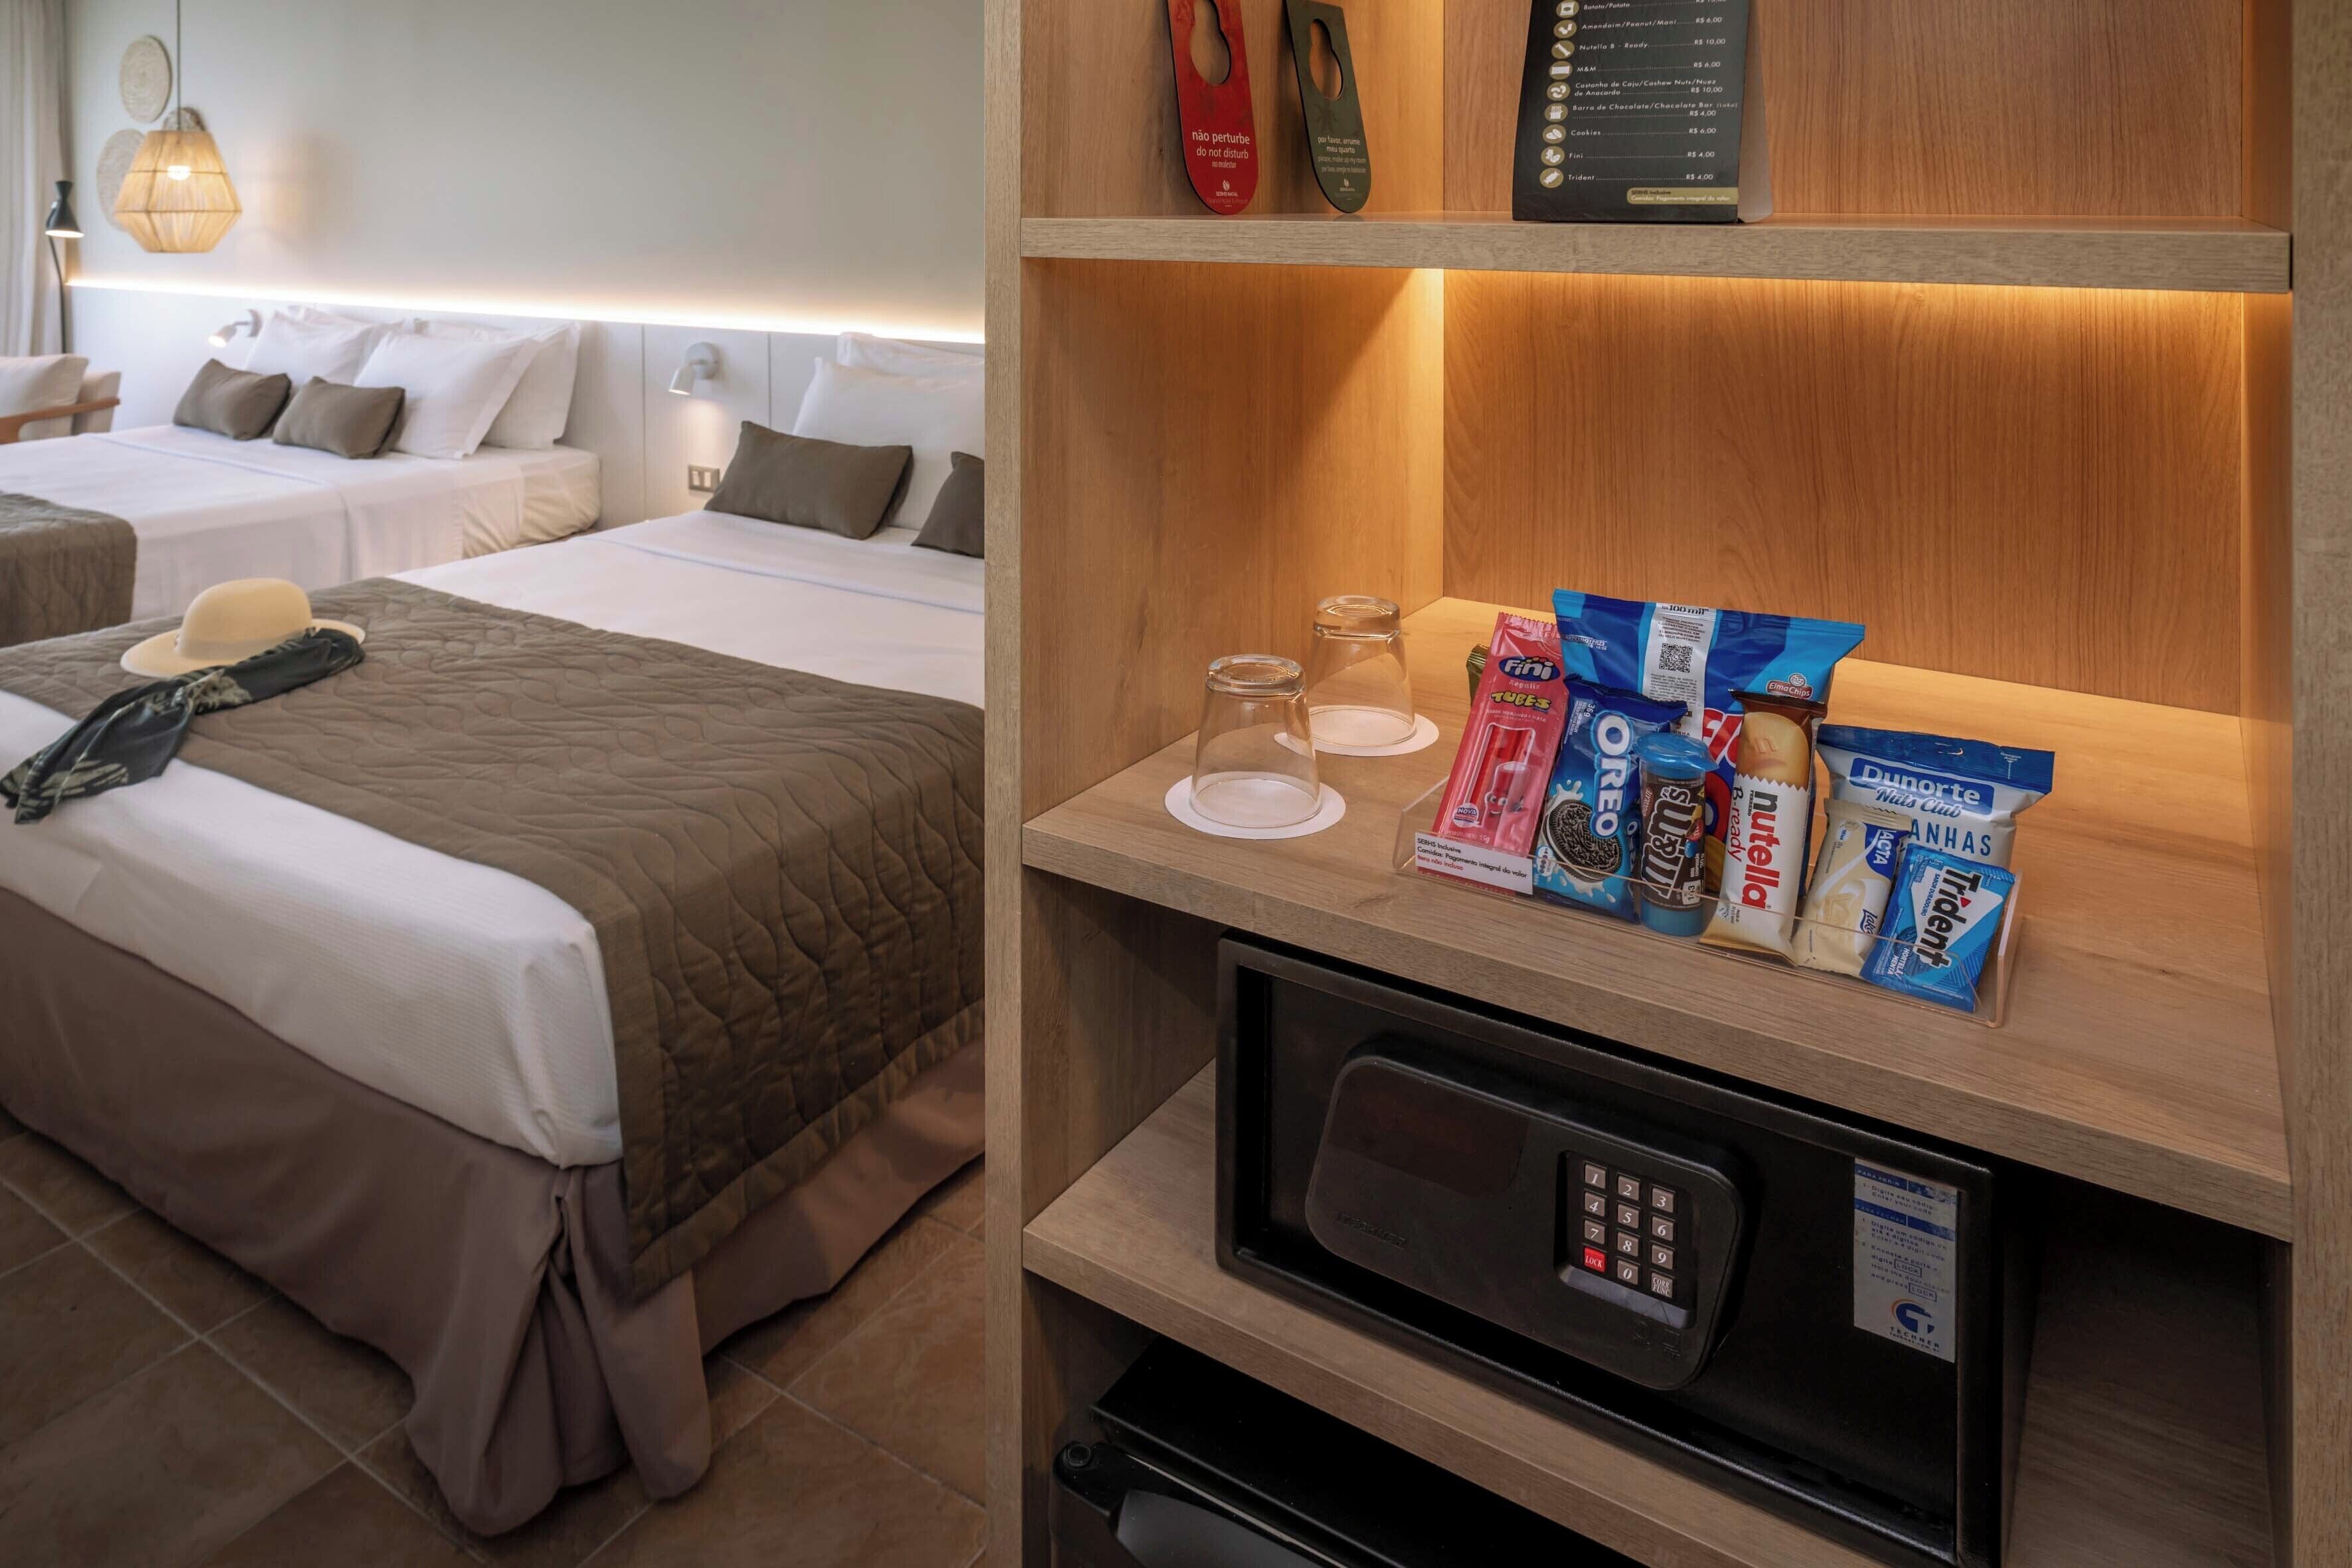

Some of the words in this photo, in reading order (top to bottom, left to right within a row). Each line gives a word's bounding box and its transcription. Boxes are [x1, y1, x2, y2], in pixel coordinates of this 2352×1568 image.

[1192, 129, 1210, 141] não
[1212, 132, 1251, 145] perturbe
[1196, 145, 1207, 157] do
[1209, 148, 1222, 158] not
[1223, 147, 1249, 159] disturb
[1504, 659, 1554, 680] Fini
[1491, 690, 1551, 710] TUBES
[1595, 714, 1630, 836] OREO
[1861, 764, 1982, 806] Dunorte
[1875, 786, 1917, 808] Nuts
[1919, 797, 1963, 819] Club
[1456, 807, 1478, 816] NOVA
[1727, 785, 1744, 862] B-ready
[1417, 838, 1436, 848] SERHS
[1437, 840, 1461, 853] Inclusive
[1741, 791, 1780, 909] nutella
[1417, 846, 1444, 858] Comidas:
[1445, 852, 1477, 866] Pagamento
[1478, 861, 1501, 872] integral
[1511, 870, 1528, 879] valor
[1417, 854, 1430, 862] Itens
[1431, 857, 1443, 866] não
[1444, 860, 1463, 871] incluso
[1921, 888, 1936, 916] DURADOURO
[1916, 868, 1982, 968] Trident
[1887, 955, 1897, 975] MENTA
[1591, 1173, 1599, 1185] 1
[1623, 1184, 1632, 1196] 2
[1589, 1201, 1599, 1212] 4
[1656, 1196, 1666, 1208] 3
[1622, 1212, 1632, 1223] 5
[1590, 1227, 1599, 1239] 7
[1657, 1225, 1667, 1237] 6
[1622, 1240, 1632, 1252] 8
[1585, 1254, 1603, 1269] LOCK
[1657, 1252, 1667, 1264] 9
[1623, 1268, 1633, 1280] 0
[1652, 1276, 1670, 1289] CORR
[1652, 1284, 1671, 1296] FUNC
